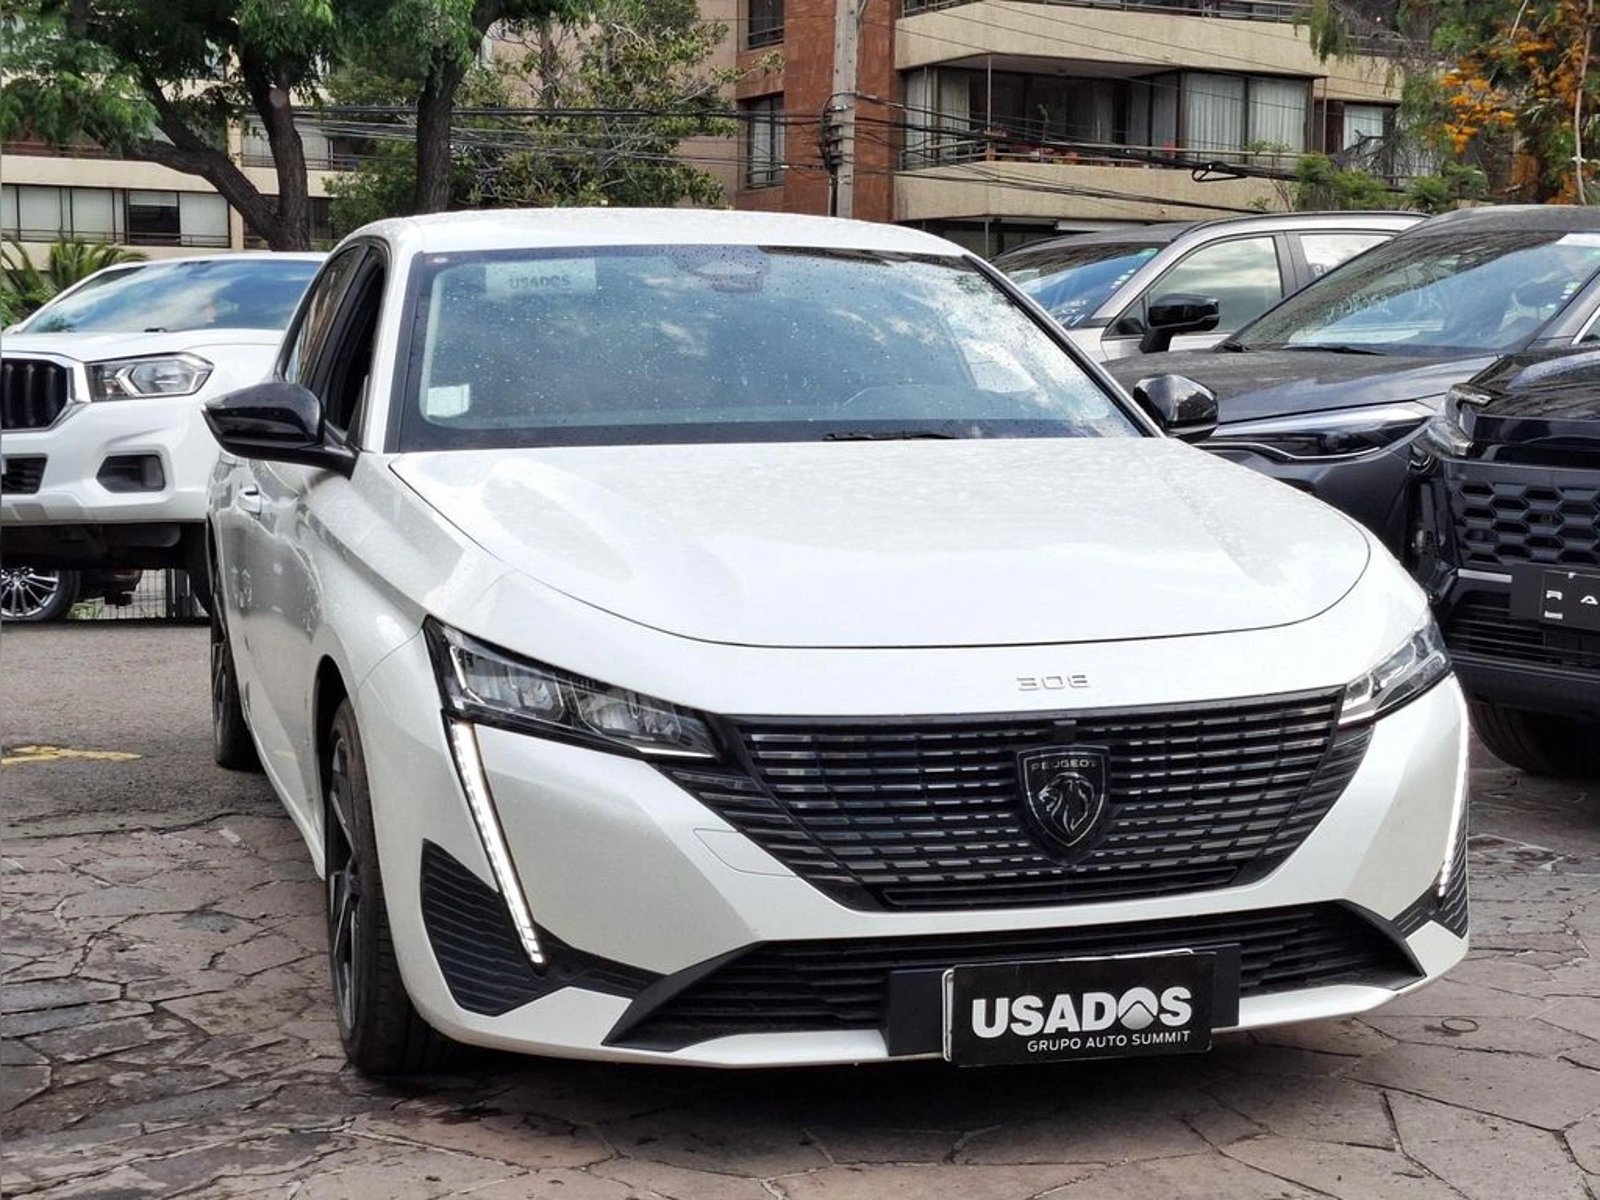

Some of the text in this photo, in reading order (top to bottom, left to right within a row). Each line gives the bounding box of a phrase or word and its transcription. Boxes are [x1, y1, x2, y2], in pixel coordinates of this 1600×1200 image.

[971, 986, 1193, 1039] USADOS
[1027, 1030, 1191, 1053] GRUPO AUTO SUMMIT
